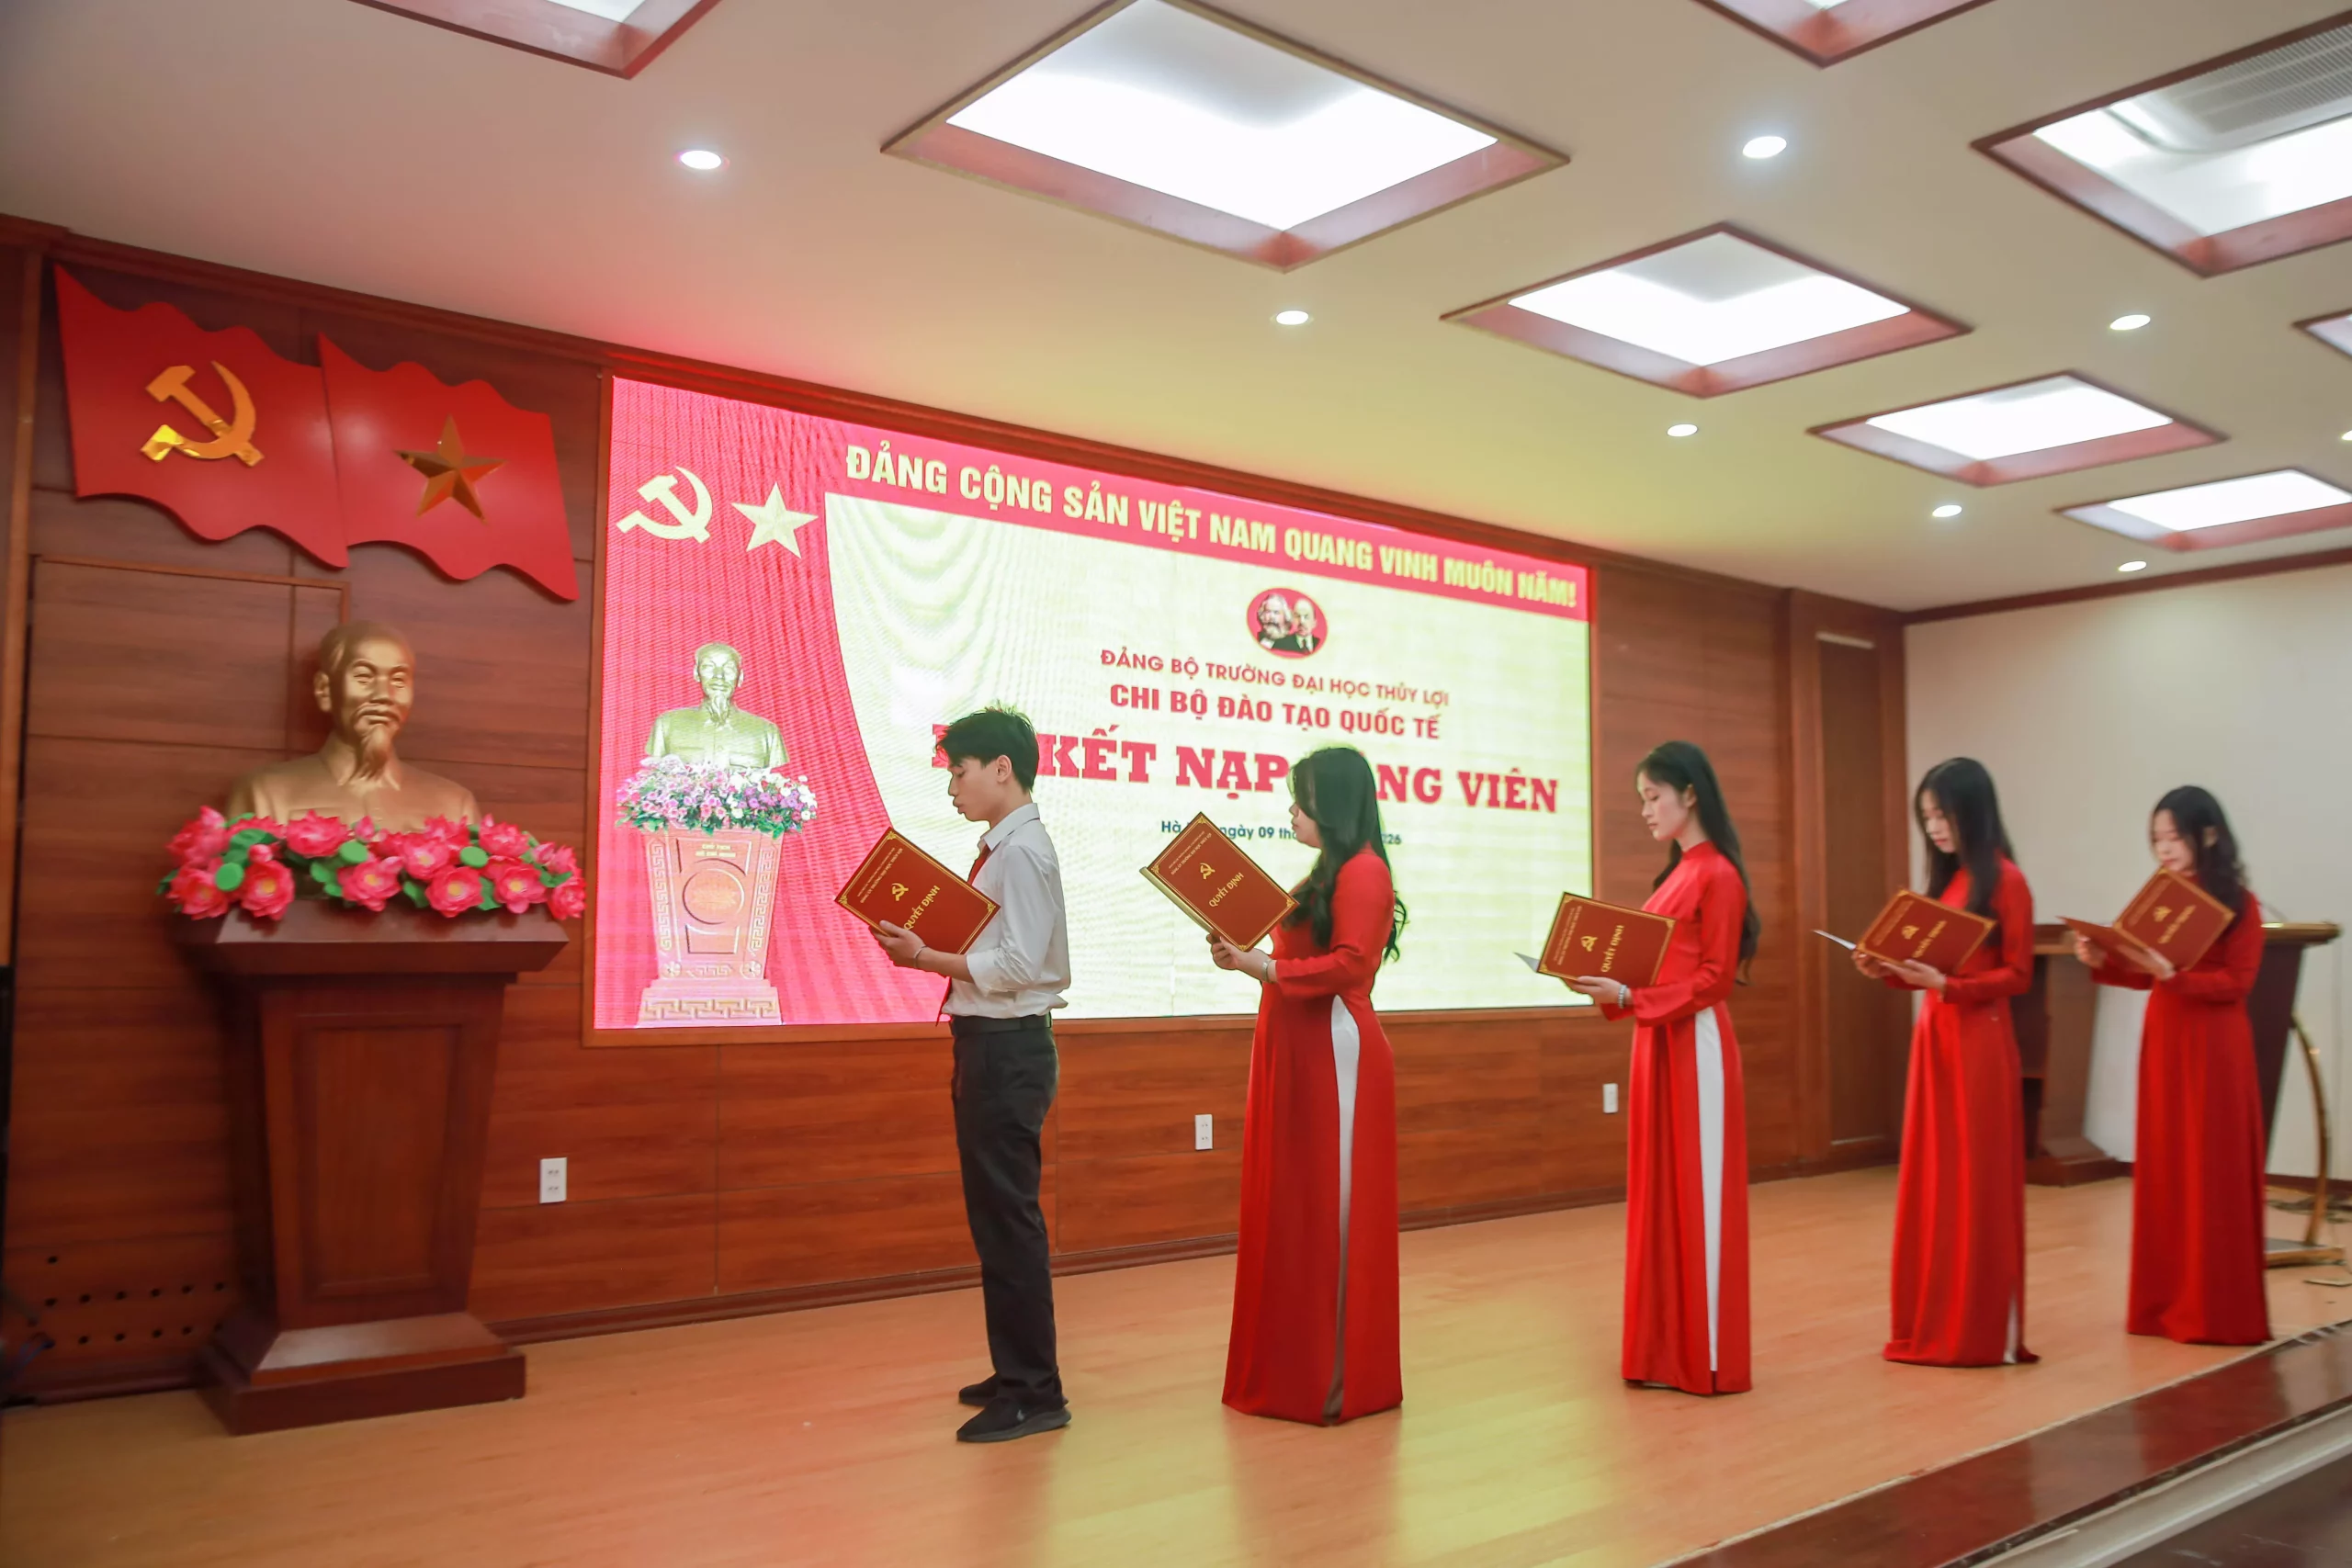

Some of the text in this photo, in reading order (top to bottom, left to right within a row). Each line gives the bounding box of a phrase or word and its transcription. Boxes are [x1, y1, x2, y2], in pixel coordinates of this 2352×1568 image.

[846, 440, 1577, 608] ĐẢNG CỘNG SẢN VIỆT NAM QUANG VINH MUÔN NĂM!
[1101, 647, 1449, 709] ĐẢNG BỘ TRƯỜNG ĐẠI HỌC THỦY LỢI
[1110, 683, 1442, 739] CHI BỘ ĐÀO TẠO QUỐC TẾ
[1036, 724, 1558, 814] KẾT NẠP NG VIÊN
[1161, 820, 1182, 833] Hà
[1219, 824, 1254, 840] ngày
[1258, 826, 1275, 840] 09
[903, 885, 941, 931] QUYẾT ĐỊNH
[1208, 872, 1245, 908] QUYẾT ĐỊNH
